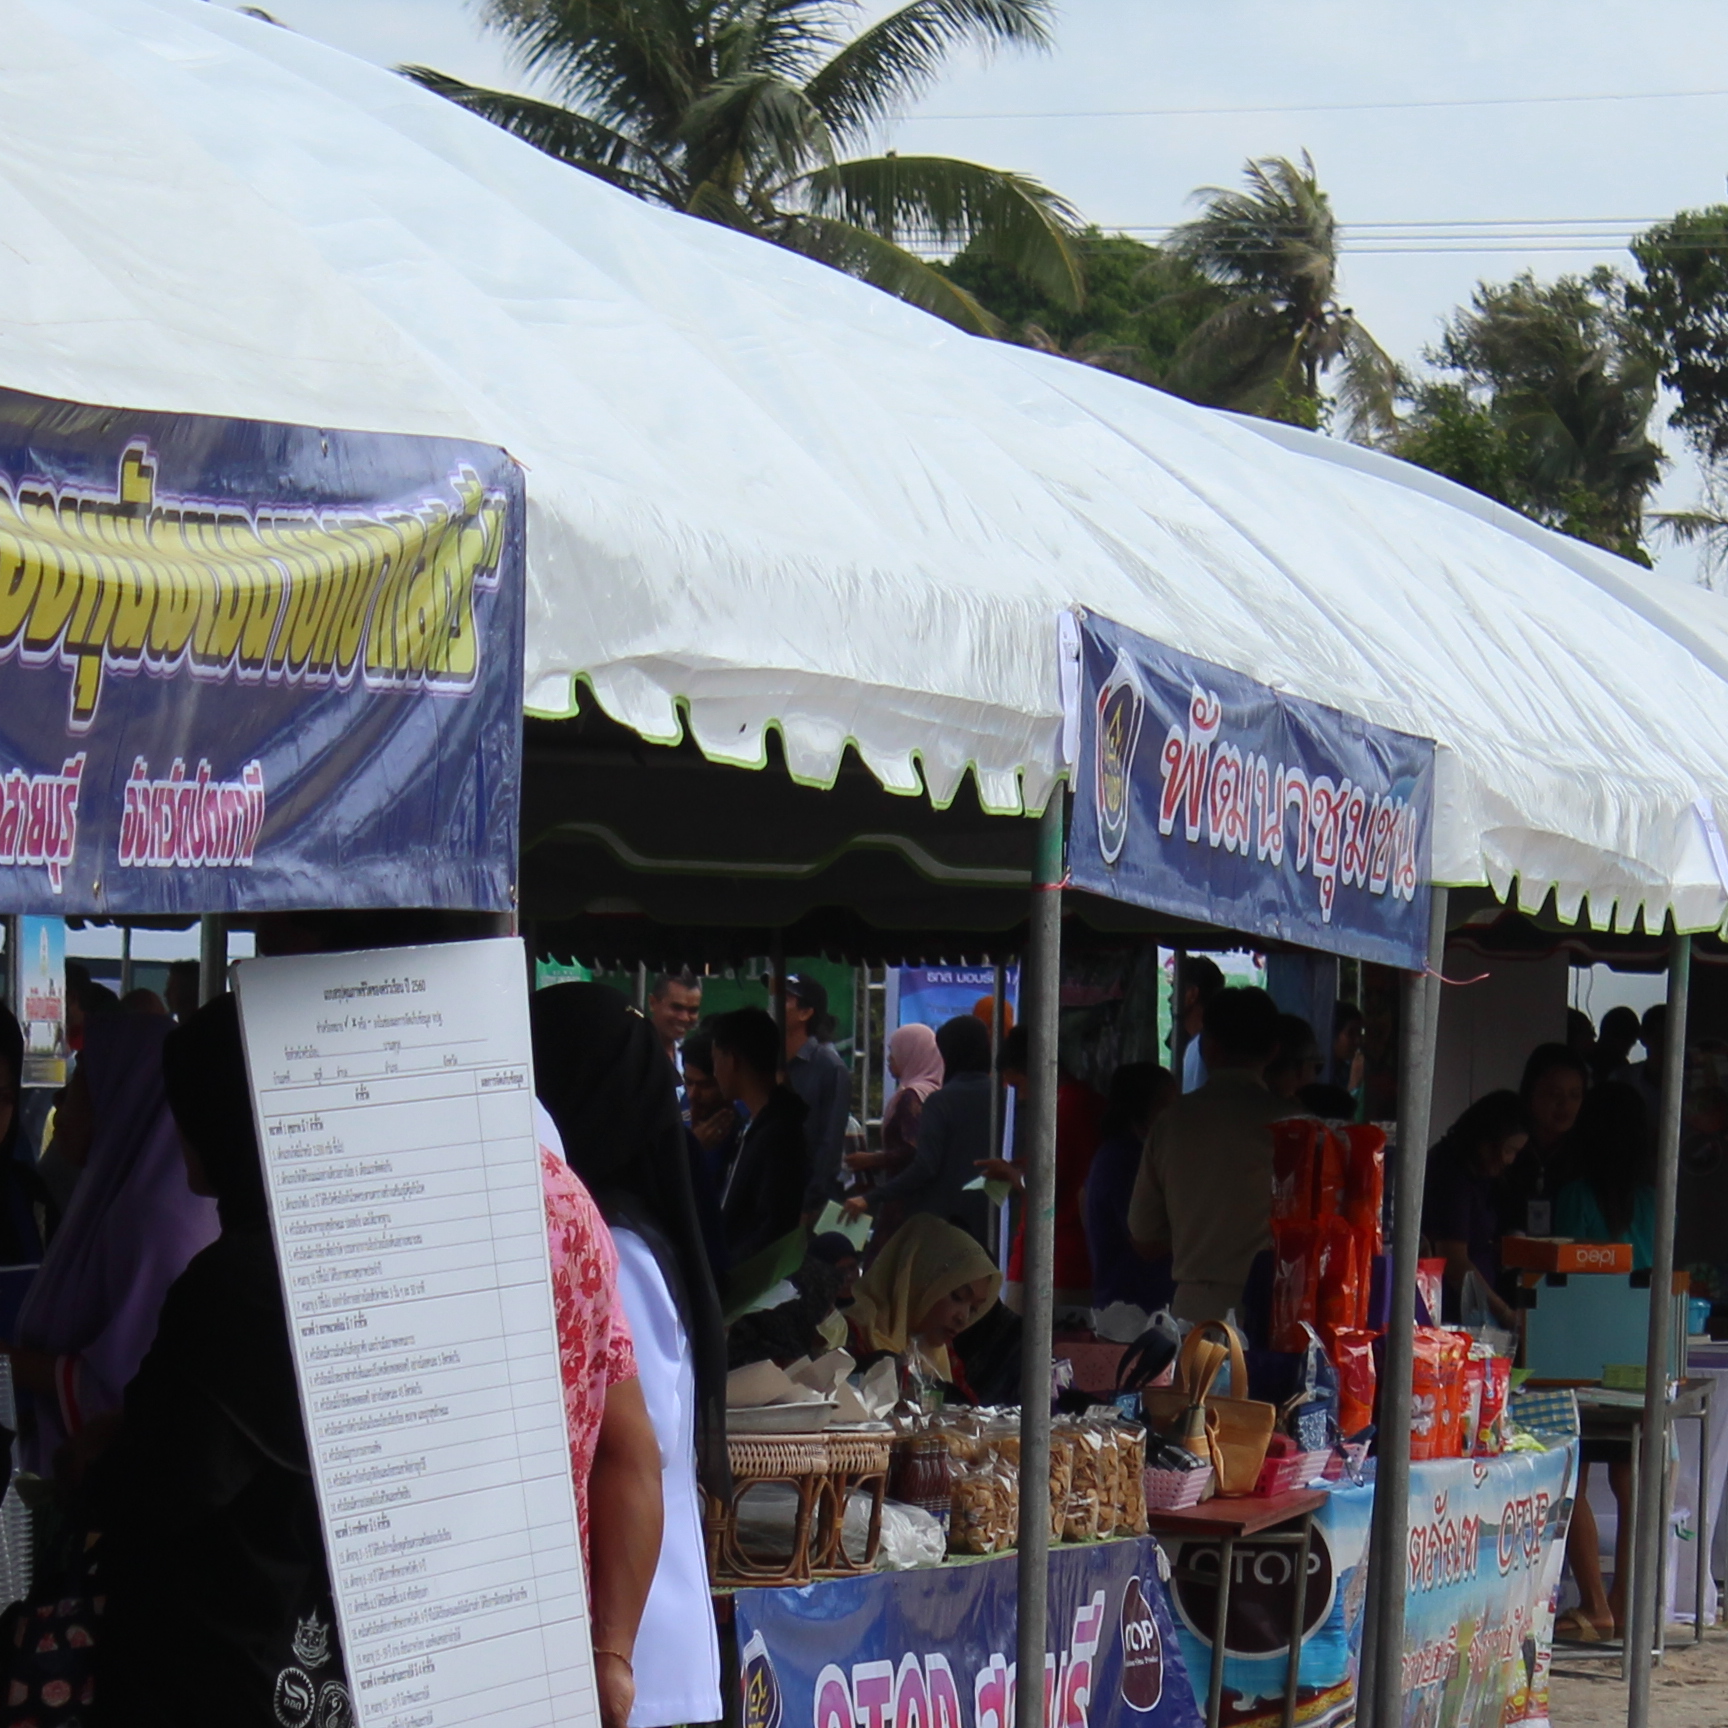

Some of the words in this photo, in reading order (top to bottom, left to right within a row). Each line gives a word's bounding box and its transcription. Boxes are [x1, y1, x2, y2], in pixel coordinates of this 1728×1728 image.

[118, 755, 265, 868] จังหวัดปัตตานี
[1159, 683, 1418, 923] พัฒนาชุมชน
